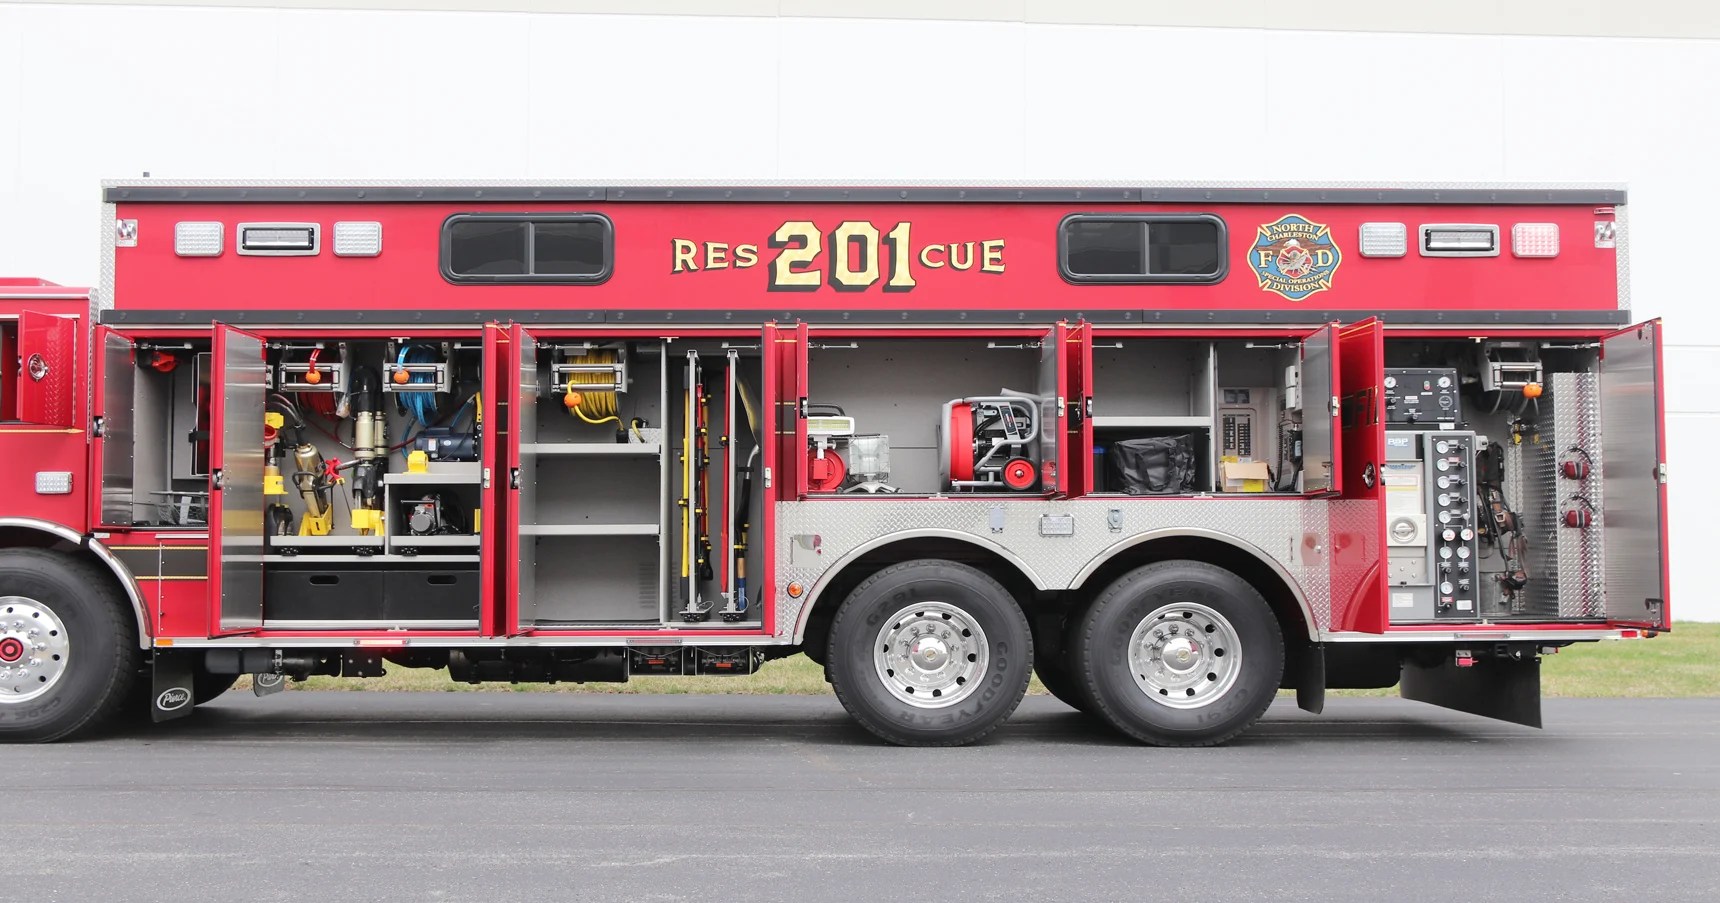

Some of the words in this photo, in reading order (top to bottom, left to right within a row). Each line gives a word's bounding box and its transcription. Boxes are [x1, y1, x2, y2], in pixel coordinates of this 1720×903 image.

[1272, 223, 1314, 233] NORTH
[1267, 231, 1320, 242] CHARLESTON
[671, 238, 759, 274] RES
[767, 220, 917, 293] 201
[918, 239, 1006, 275] CUE
[1258, 250, 1273, 268] F
[1315, 249, 1334, 267] D
[1261, 271, 1287, 284] SPECIAL
[1288, 270, 1329, 284] OPERATIONS
[1272, 282, 1319, 292] DIVISION
[900, 641, 1008, 725] GOODYEAR
[162, 692, 186, 706] Pierce
